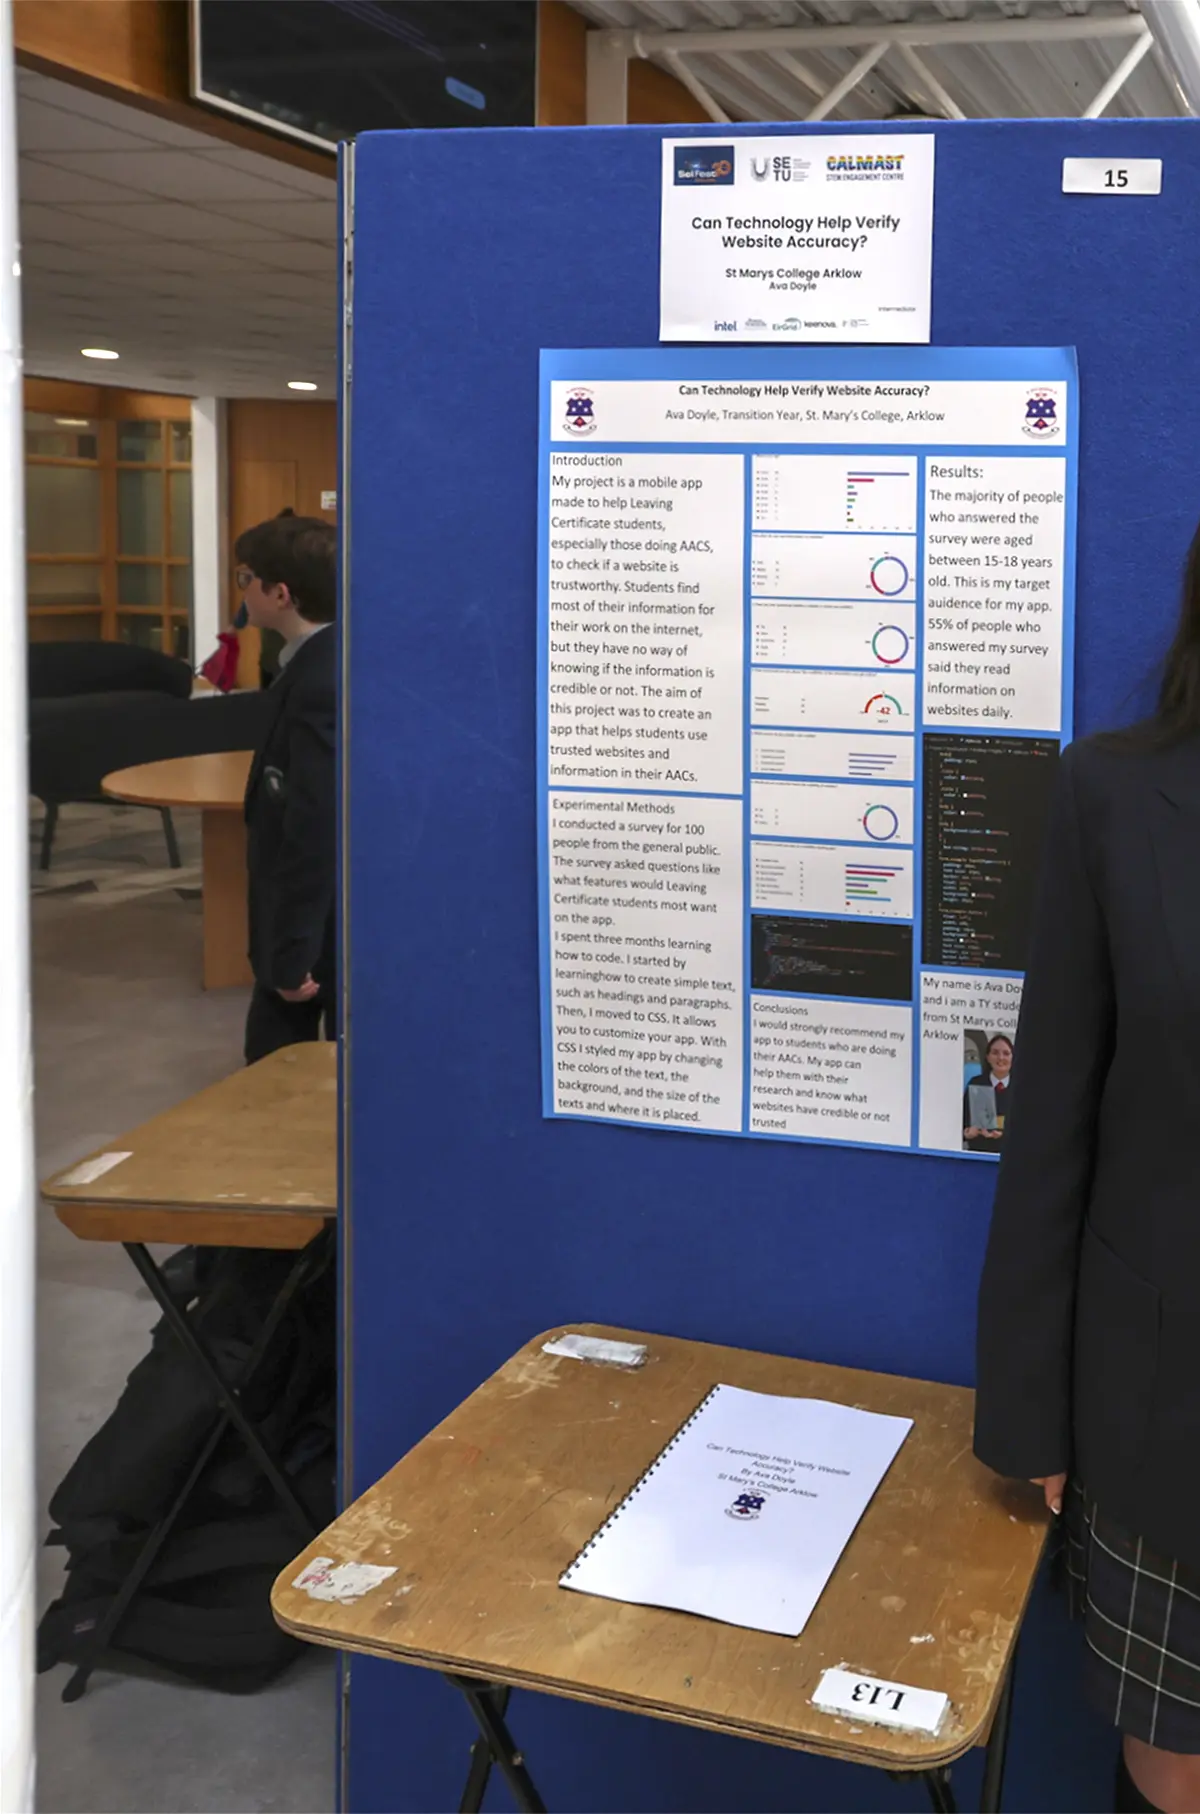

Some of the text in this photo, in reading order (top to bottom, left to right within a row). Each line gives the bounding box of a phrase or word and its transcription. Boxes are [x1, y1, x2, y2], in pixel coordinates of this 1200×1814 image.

[772, 156, 792, 169] SE
[826, 154, 904, 171] CALMAST
[773, 170, 792, 182] TU
[1103, 169, 1128, 188] 15
[691, 214, 900, 233] Can Technology Help Verify
[721, 233, 868, 252] Website Accuracy?
[725, 267, 862, 282] St Marys College Arklow
[768, 281, 817, 292] Ava Doyle
[714, 320, 738, 332] intel
[678, 384, 930, 398] Can Technology Help Verify Website Accuracy?
[664, 408, 945, 423] Ava Doyle, Transition Year, St. Mary's College, Arklow
[552, 454, 623, 467] Introduction
[930, 464, 983, 478] Results:
[552, 474, 703, 491] My project is a mobile app
[551, 496, 673, 512] made to help Leaving
[929, 488, 1063, 504] The majority of people
[551, 516, 666, 532] Certificate students,
[928, 510, 1039, 524] who answered the
[551, 537, 713, 554] especially those doing AACS,
[928, 534, 1033, 548] survey were aged
[551, 558, 679, 572] to check if a website is
[928, 553, 1053, 570] between 15-18 years
[550, 579, 700, 594] trustworthy. Students find
[927, 575, 1050, 592] old. This is my target
[550, 599, 715, 615] most of their information for
[927, 596, 1052, 614] auidence for my app.
[928, 617, 1041, 633] 55% of people who
[552, 798, 675, 814] Experimental Methods
[552, 818, 705, 836] I conducted a survey for 100
[552, 837, 721, 856] people from the general public.
[752, 1001, 809, 1016] Conclusions
[753, 1018, 905, 1042] I would strongly recommend my
[922, 1028, 959, 1041] Arklow
[706, 1442, 851, 1476] Can Technology Help Verify Website
[751, 1460, 794, 1474] Accuracy?
[740, 1468, 796, 1484] By Ava Doyle
[728, 1475, 755, 1486] Mary's
[757, 1480, 788, 1493] College
[789, 1487, 819, 1498] Arklow
[852, 1682, 908, 1712] L13
